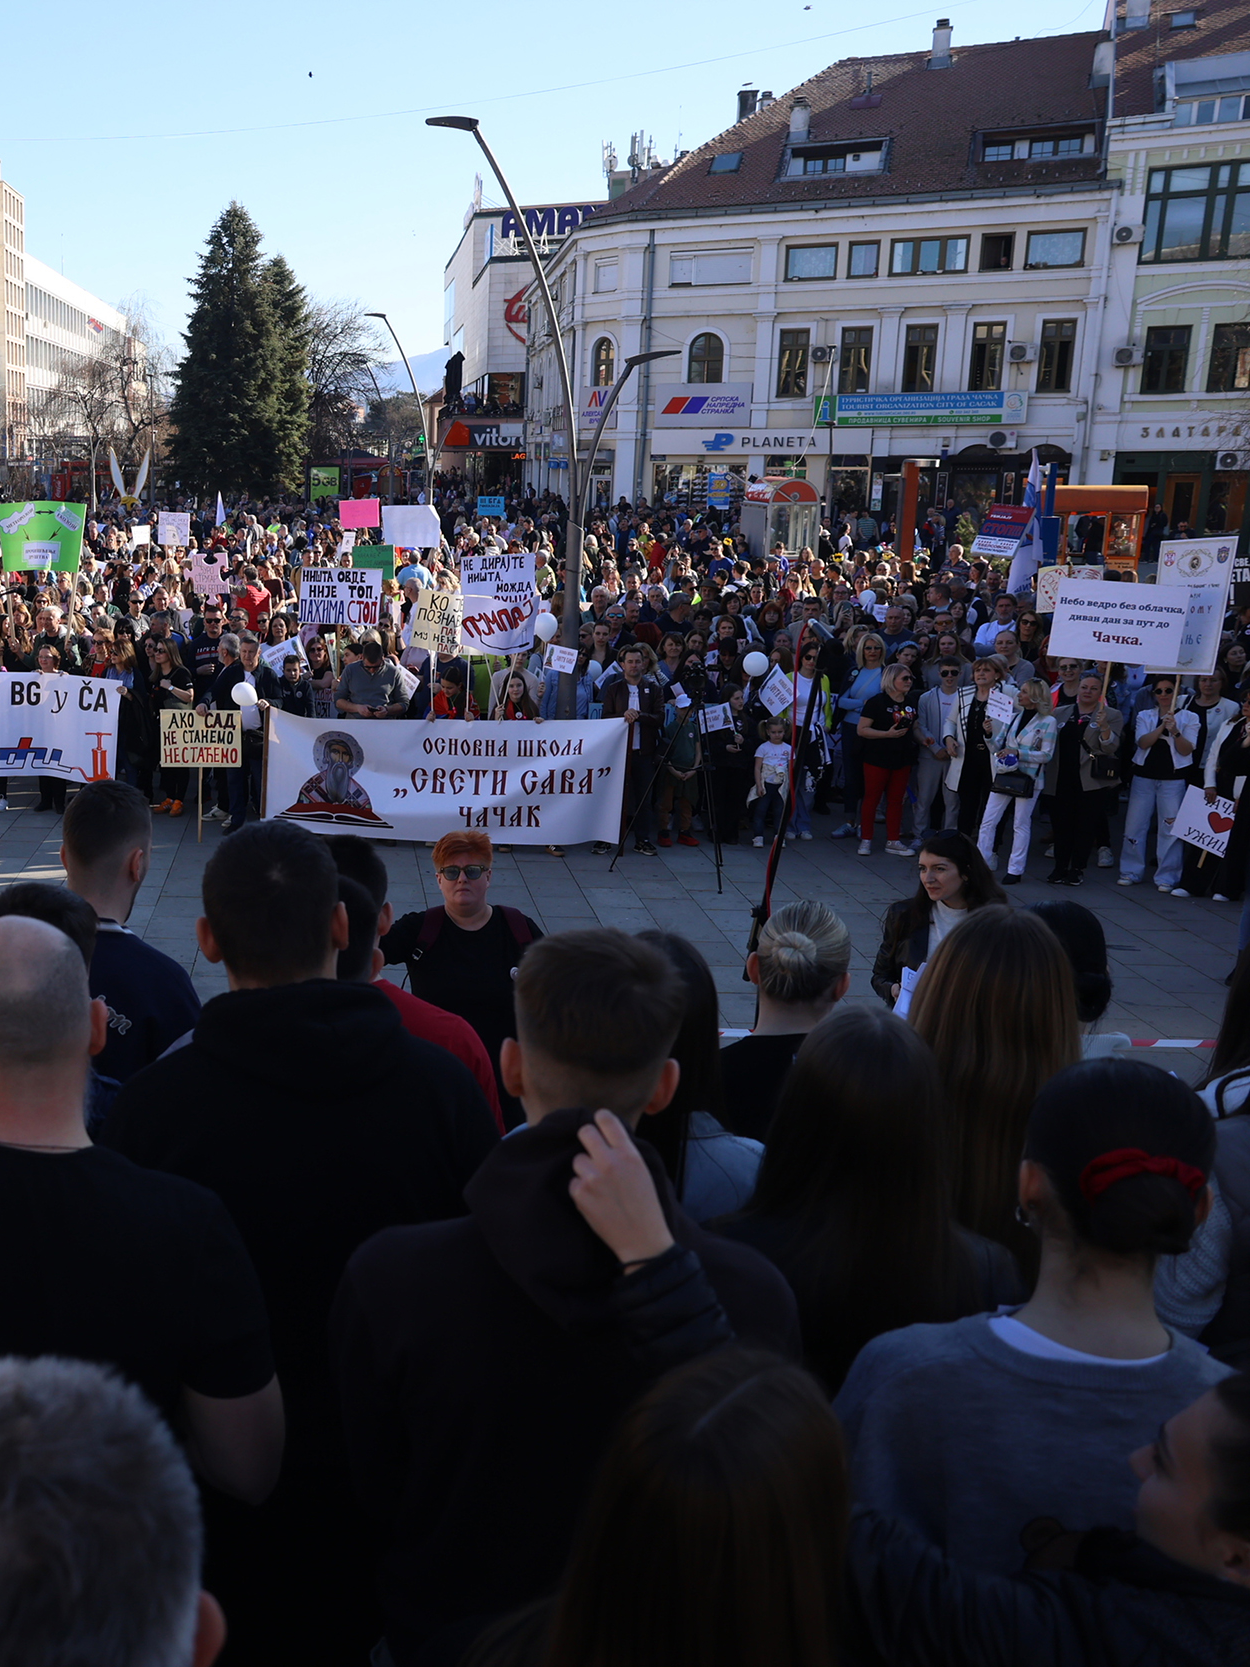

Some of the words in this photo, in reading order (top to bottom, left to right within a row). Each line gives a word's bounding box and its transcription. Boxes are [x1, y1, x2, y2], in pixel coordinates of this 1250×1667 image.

[848, 416, 891, 424] ПРОДАВНИЦА
[893, 415, 927, 423] СУВЕНИРА
[1140, 425, 1242, 438] ЗЛАТАРА
[741, 436, 817, 448] PLANETA
[463, 559, 474, 571] НЕ
[479, 555, 525, 573] ДИРАЈТЕ
[302, 570, 334, 583] НИШТА
[337, 571, 367, 584] ОВДЕ
[309, 585, 337, 598] НИЈЕ
[496, 581, 533, 593] МОЖДА
[430, 594, 450, 611] КО
[1059, 596, 1086, 607] Небо
[1087, 599, 1118, 610] ведро
[1119, 600, 1137, 611] без
[1138, 603, 1186, 615] облачка,
[347, 600, 378, 625] СТОП
[461, 600, 534, 638] ПУМПАЈ
[1069, 613, 1100, 625] диван
[1101, 615, 1121, 626] дан
[1122, 617, 1135, 626] за
[1136, 618, 1155, 630] пут
[1155, 620, 1170, 629] до
[413, 630, 428, 641] МУ
[1092, 630, 1143, 647] Чачка.
[436, 642, 464, 654] ПАСТИ
[10, 680, 41, 707] BG
[50, 689, 68, 714] у
[78, 679, 109, 713] ČA
[168, 712, 195, 730] АКО
[204, 712, 237, 731] САД
[163, 731, 178, 746] НЕ
[182, 729, 234, 745] СТАНЕМО
[164, 747, 238, 764] НЕСТАЋЕМО
[422, 736, 508, 757] ОСНОВНА
[517, 738, 584, 758] ШКОЛА
[520, 766, 612, 797] САВА”
[458, 804, 542, 828] ЧАЧАК
[1184, 826, 1227, 857] УЖИЦ
